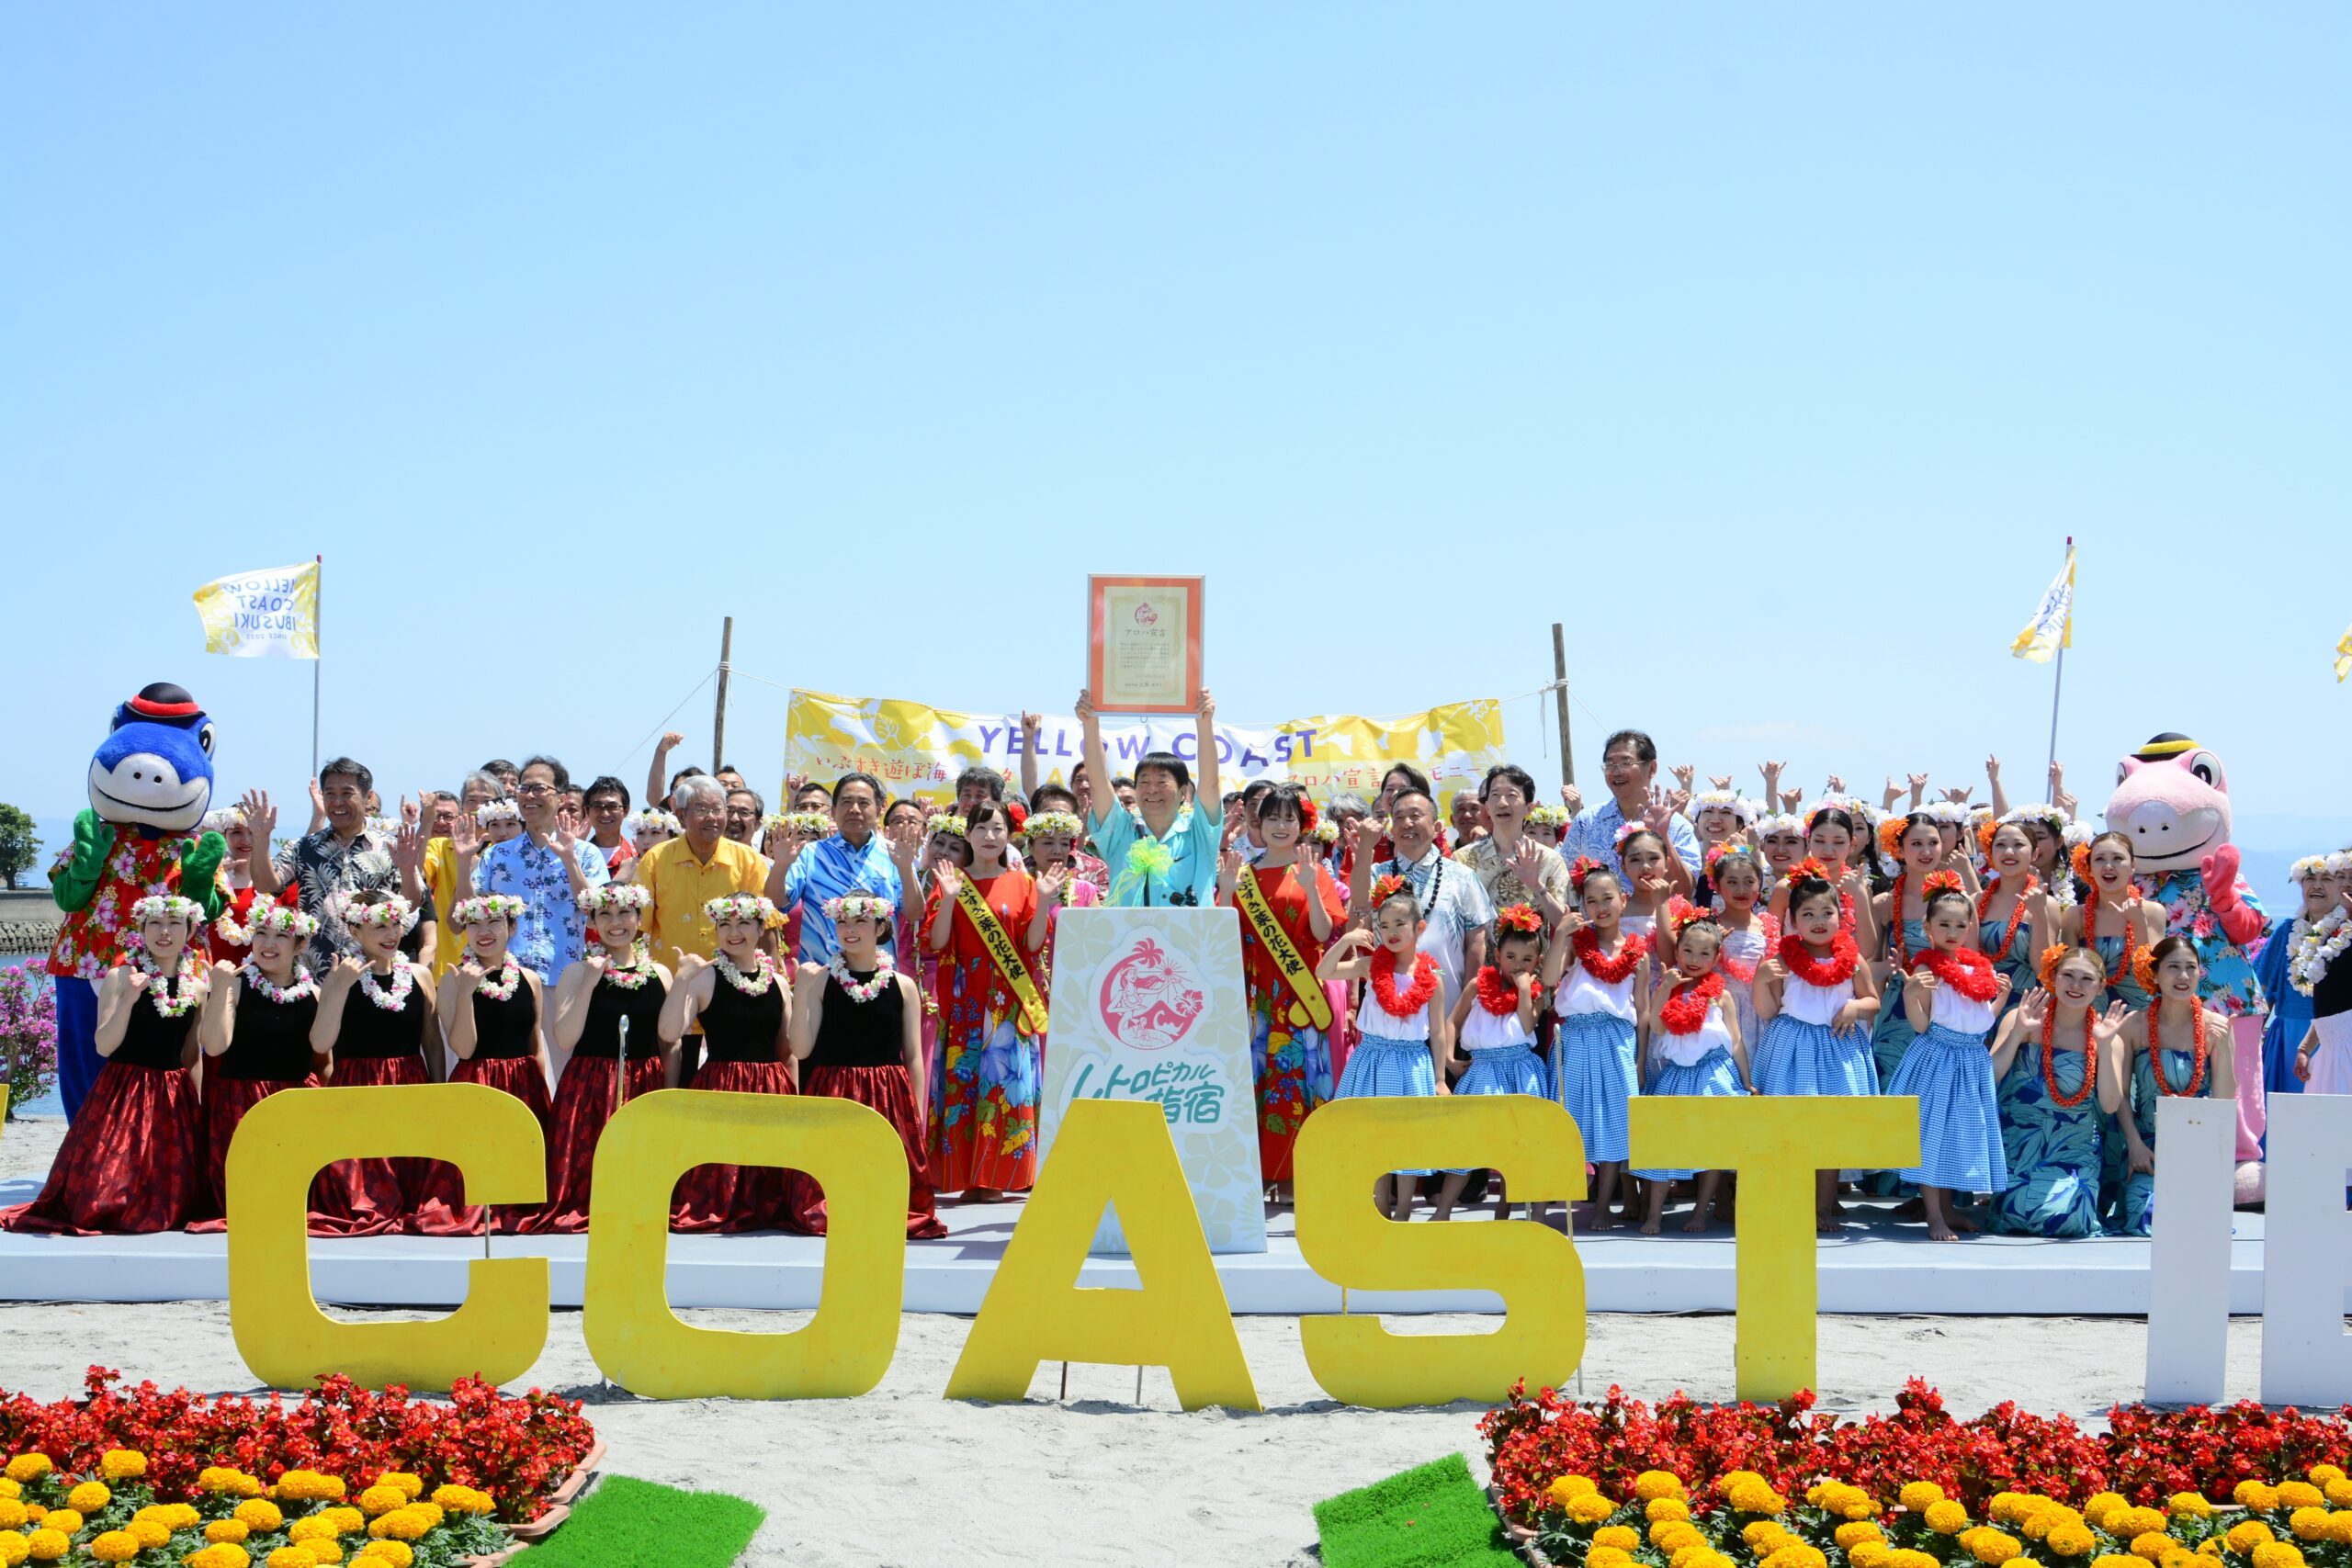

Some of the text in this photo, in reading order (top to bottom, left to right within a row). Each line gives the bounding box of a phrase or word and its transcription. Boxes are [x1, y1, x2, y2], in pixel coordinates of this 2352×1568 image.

[958, 880, 1025, 981] ぶすき菜の花大使
[225, 1082, 1921, 1412] COAST
